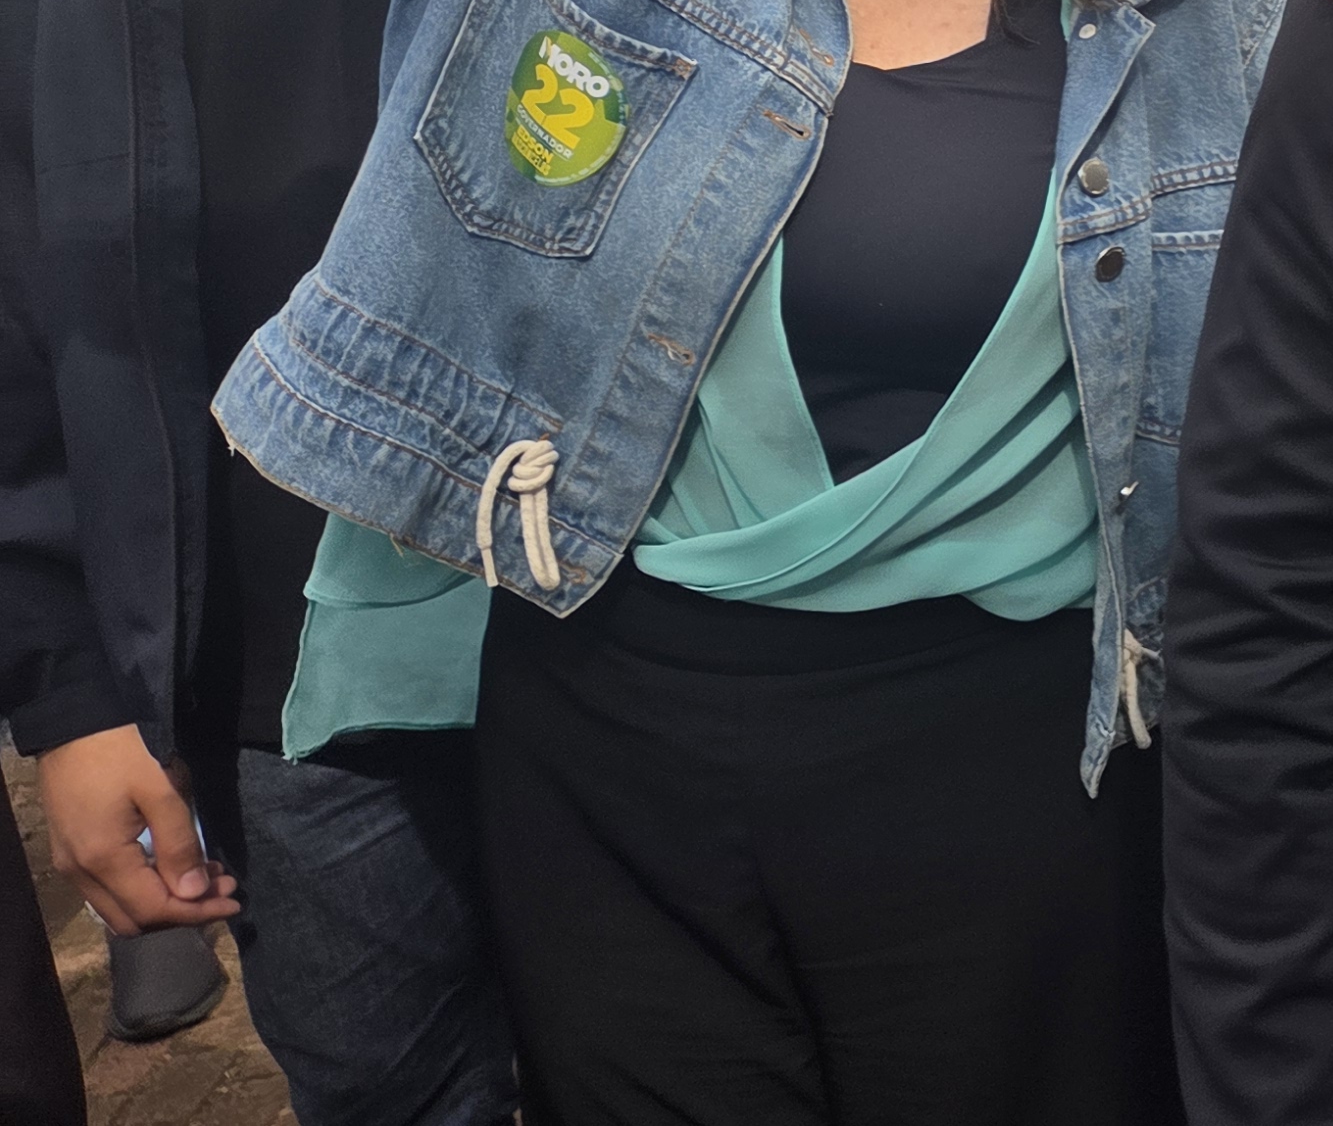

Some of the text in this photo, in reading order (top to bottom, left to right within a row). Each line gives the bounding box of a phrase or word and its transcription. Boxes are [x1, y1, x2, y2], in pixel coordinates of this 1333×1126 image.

[539, 35, 611, 98] MORO
[521, 63, 595, 149] 22
[517, 124, 554, 164] EDSON
